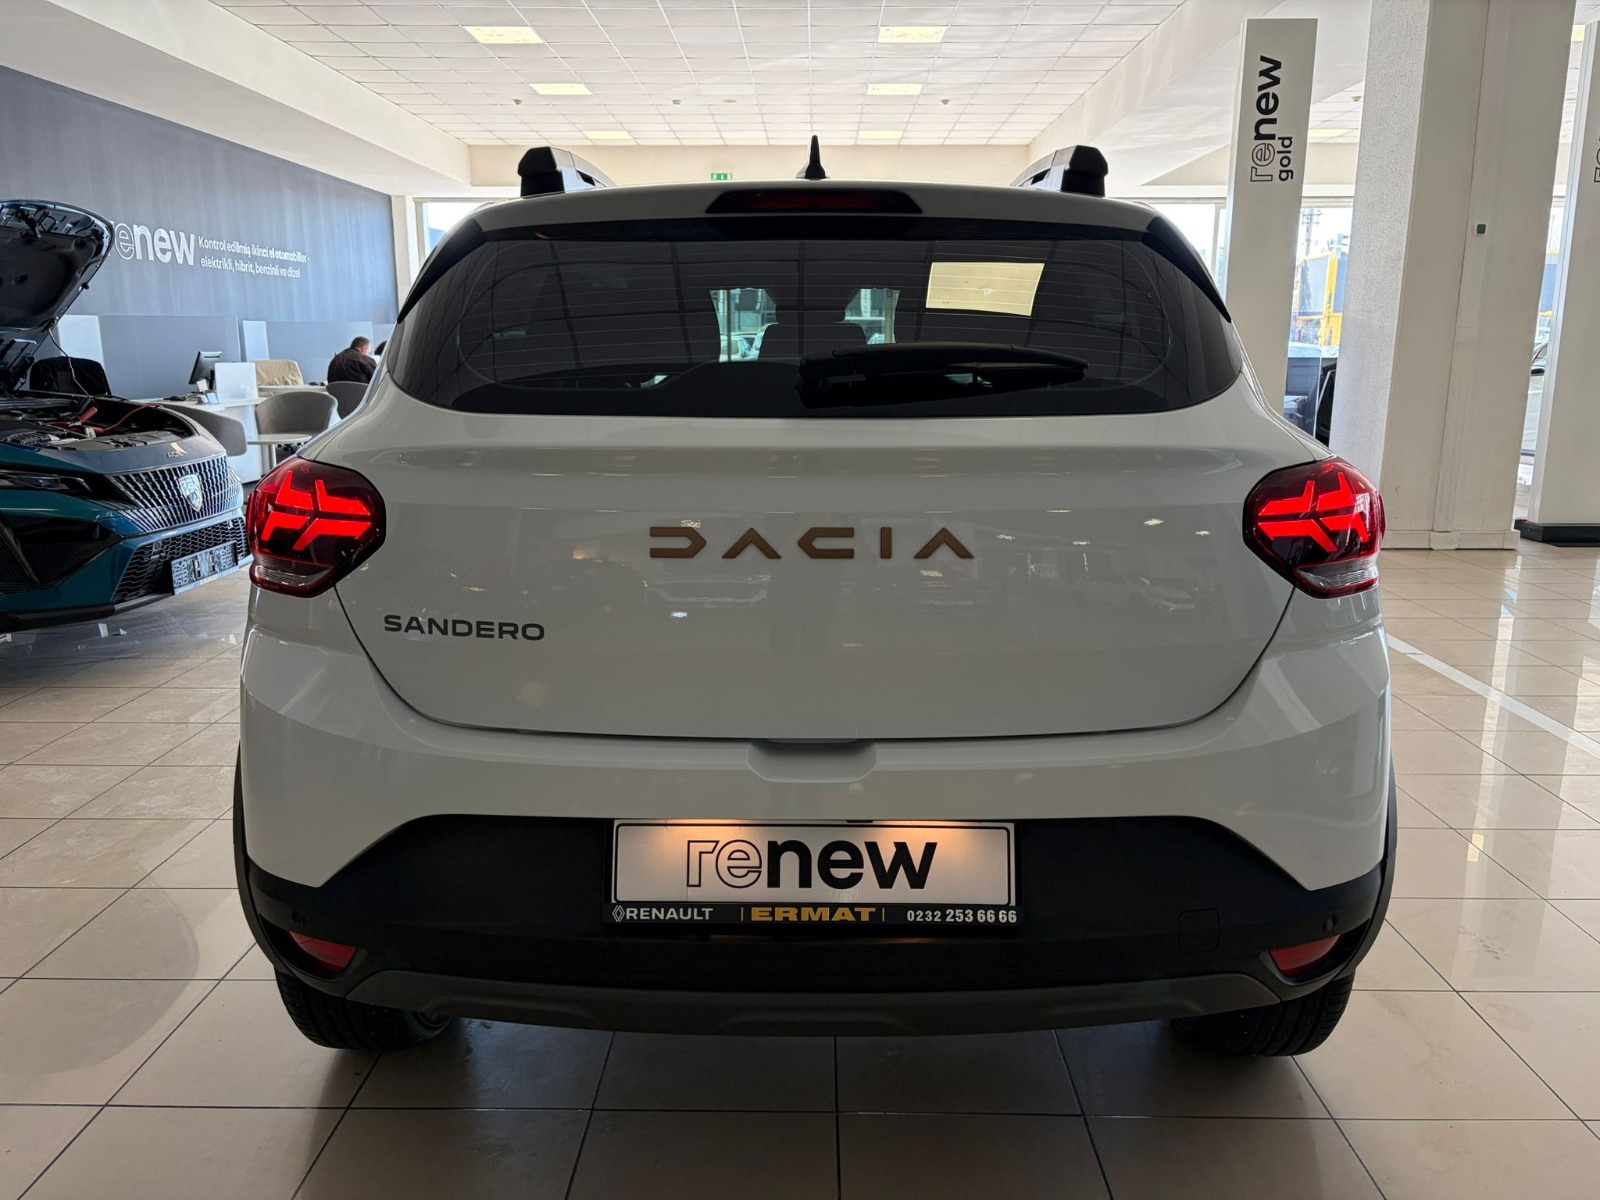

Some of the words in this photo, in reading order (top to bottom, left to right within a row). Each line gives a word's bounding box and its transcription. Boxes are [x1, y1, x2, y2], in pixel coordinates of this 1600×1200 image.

[1250, 55, 1282, 182] renew
[1277, 136, 1294, 182] gold
[109, 220, 195, 266] enew
[198, 235, 226, 251] Kontrol
[226, 240, 251, 258] edilmiş
[268, 247, 275, 259] el
[200, 255, 235, 272] elektrikli,
[234, 259, 255, 275] hibrit,
[649, 527, 974, 559] DACIA
[384, 614, 545, 641] SANDERO
[686, 839, 938, 890] renew
[625, 907, 714, 920] RENAULT
[751, 906, 876, 922] ERMAT
[906, 910, 942, 922] 0232
[945, 909, 974, 922] 253
[976, 909, 996, 923] 66
[998, 910, 1018, 923] 66
